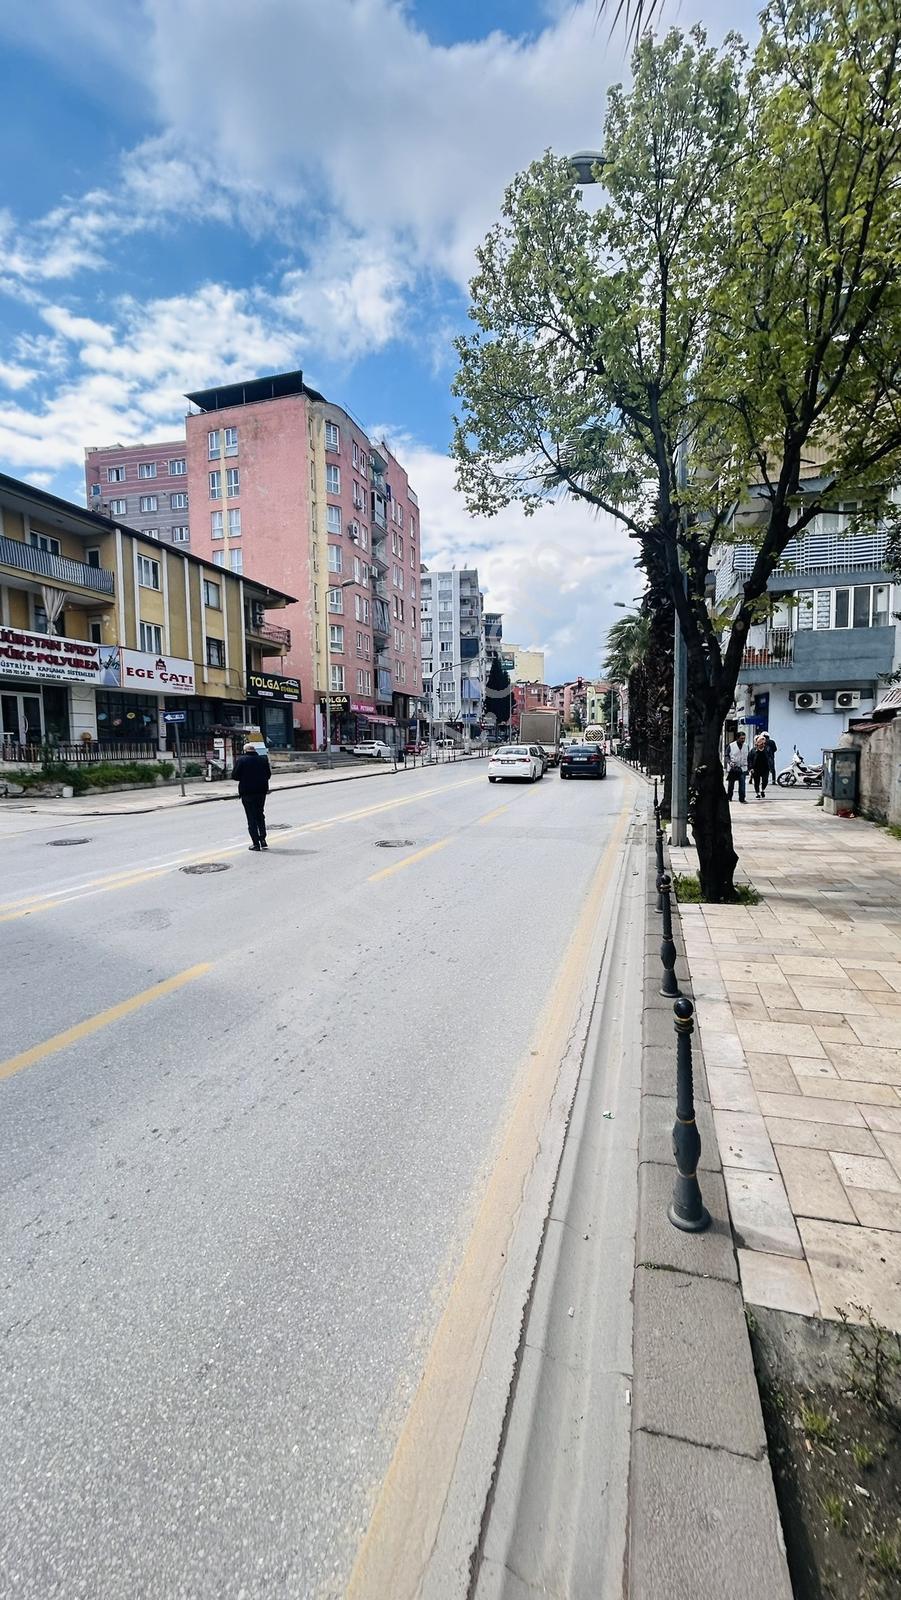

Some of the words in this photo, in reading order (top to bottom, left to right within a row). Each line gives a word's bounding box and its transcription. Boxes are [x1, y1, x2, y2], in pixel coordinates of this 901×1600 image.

[64, 642, 97, 656] SPREY
[37, 666, 65, 674] KAPLAMA
[126, 667, 154, 679] EGE
[160, 672, 193, 684] ÇATI
[250, 676, 280, 690] TOLGA
[320, 696, 348, 704] TOLGA
